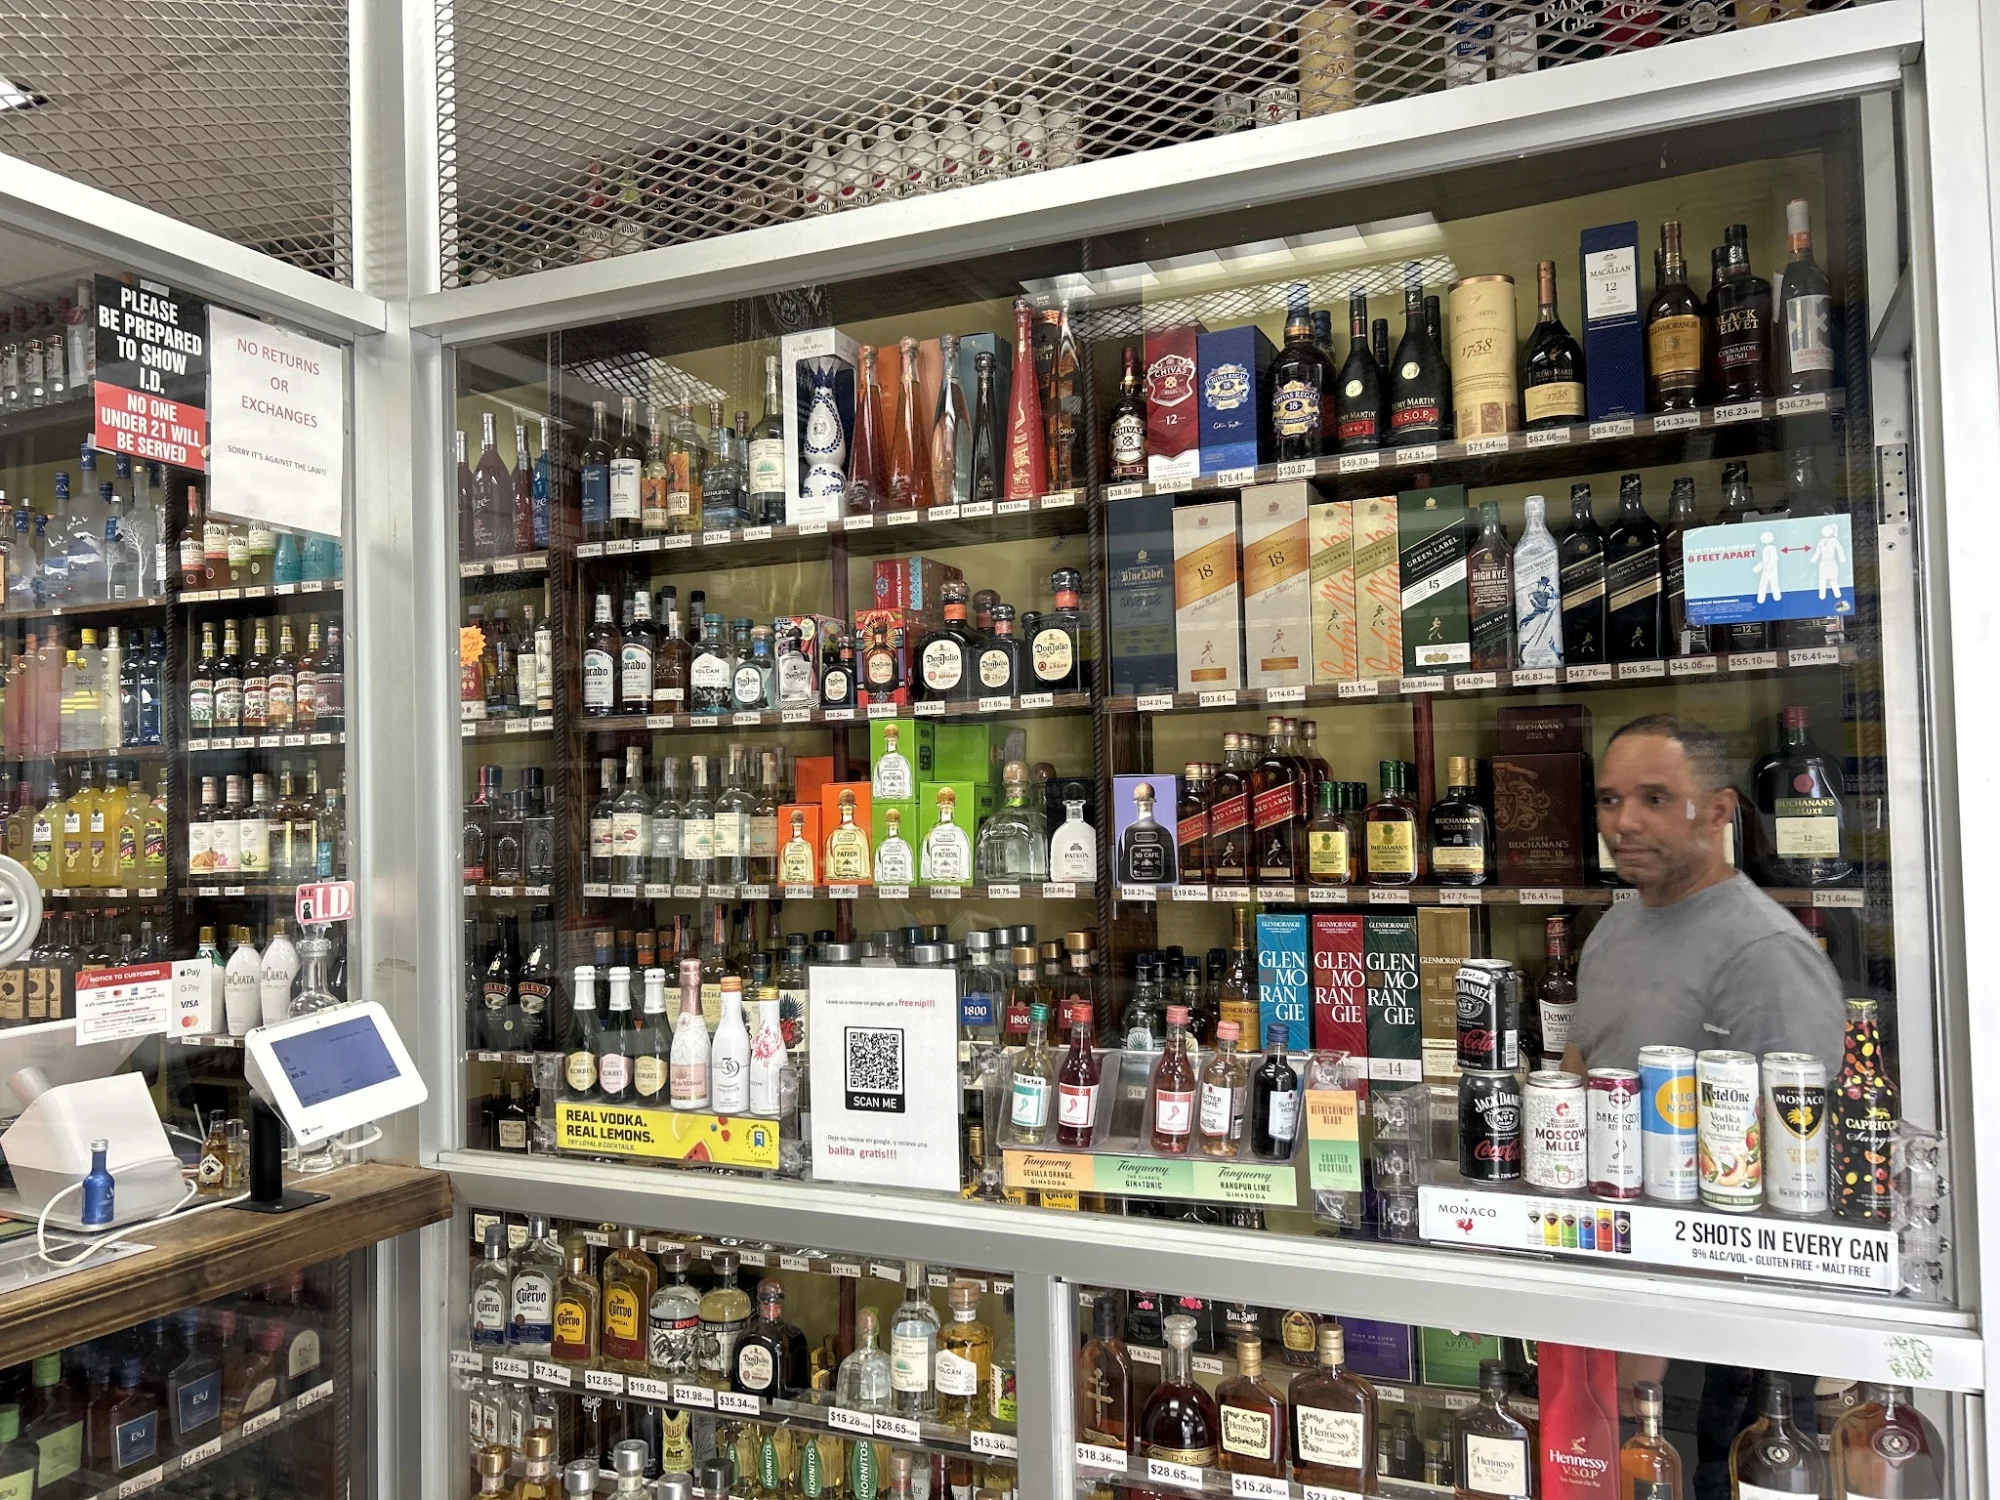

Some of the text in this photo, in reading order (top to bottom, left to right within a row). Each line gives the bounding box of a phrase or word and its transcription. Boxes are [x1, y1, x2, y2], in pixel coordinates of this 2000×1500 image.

[1590, 263, 1632, 277] MACALLAN
[1604, 281, 1617, 292] 12
[120, 287, 178, 325] PLEASE
[99, 305, 202, 356] BE PREPARED
[117, 335, 188, 376] TO SHOW
[1461, 337, 1493, 359] 1738
[1718, 344, 1757, 359] CINNAMON
[237, 338, 321, 376] NO RETURNS
[1726, 352, 1748, 363] RUSH
[1154, 365, 1188, 379] CHIVAS
[140, 367, 166, 394] I.D.
[270, 376, 290, 394] OR
[1273, 389, 1319, 406] CHIVAS REGAL
[1406, 396, 1436, 406] MARTIN
[127, 395, 178, 423] NO ONE
[241, 395, 319, 429] EXCHANGES
[1288, 401, 1299, 411] 18
[1165, 413, 1178, 426] 12
[1349, 410, 1377, 420] MARTIN
[101, 407, 202, 449] UNDER 21 WILL
[1114, 425, 1144, 439] CHIVAS
[116, 431, 187, 463] BE SERVED
[227, 444, 250, 457] SORRY
[264, 454, 294, 469] AGAINST
[294, 462, 308, 472] THE
[1267, 550, 1285, 569] 18
[1688, 549, 1757, 563] 6 FEET APART
[1196, 563, 1214, 581] 18
[1472, 569, 1507, 581] HIGH RYE
[1427, 579, 1440, 590] 15
[1741, 625, 1752, 633] 12
[1254, 794, 1293, 814] RED LABEL
[1775, 797, 1835, 808] BUCHANAN'S
[1434, 816, 1480, 825] BUCHANAN'S
[1442, 823, 1474, 832] MASTER
[1508, 840, 1570, 850] BUCHANAN'S
[1803, 834, 1813, 842] 12
[145, 841, 162, 857] MIX
[300, 884, 352, 919] WE I.D.
[1261, 920, 1301, 929] GLENMORANGIE
[1316, 920, 1359, 930] GLENMORANGIE
[1368, 921, 1411, 930] GLENMORANGIE
[1259, 950, 1306, 969] GLEN
[1313, 951, 1363, 970] GLEN
[1366, 952, 1416, 972] GLEN
[90, 975, 112, 983] NOTICE
[124, 969, 160, 979] CUSTOMERS
[1275, 969, 1309, 987] MO
[1331, 970, 1366, 988] MO
[1383, 971, 1419, 989] MO
[1259, 985, 1298, 1004] RAN
[1315, 986, 1355, 1005] RAN
[1367, 988, 1407, 1007] RAN
[180, 999, 199, 1009] VISA
[898, 998, 914, 1008] free
[963, 1004, 987, 1016] 1800
[1275, 1003, 1306, 1022] GIE
[1331, 1004, 1363, 1023] GIE
[1384, 1006, 1416, 1026] GIE
[1388, 1061, 1403, 1076] 14
[853, 1095, 897, 1109] SCAN ME
[1474, 1092, 1499, 1113] JACK
[1714, 1102, 1750, 1111] BOTANICAL
[1775, 1093, 1825, 1106] MONACO
[566, 1109, 648, 1128] REAL VODKA.
[1709, 1111, 1741, 1123] Vodka
[566, 1125, 655, 1144] REAL LEMONS.
[1535, 1127, 1588, 1140] MOSCOW
[1710, 1121, 1741, 1134] Spritz
[577, 1139, 597, 1147] LOYAL
[828, 1144, 855, 1157] balita
[1545, 1140, 1581, 1152] MULE
[1022, 1154, 1072, 1171] Tanqueray
[1116, 1158, 1170, 1177] Tanqueray
[1317, 1162, 1353, 1174] COCKTAILS
[1022, 1168, 1046, 1180] SEVILLA
[1218, 1164, 1273, 1183] Tanqueray
[1219, 1181, 1271, 1193] RANGPUR LIME
[1437, 1204, 1498, 1219] MONACO
[1675, 1220, 1889, 1263] 2 SHOTS IN EVERY CAN
[1692, 1247, 1871, 1278] 9% ALC/VOL GLUTEN FREE MALT FREE
[525, 1281, 538, 1292] Jose
[516, 1288, 546, 1306] Cuervo
[613, 1294, 625, 1305] Jose
[476, 1300, 500, 1314] Cuervo
[608, 1302, 632, 1319] Cuervo
[556, 1313, 580, 1328] Cuervo
[1443, 1338, 1479, 1350] APPLE
[192, 1389, 208, 1406] E&J
[1229, 1420, 1261, 1437] Hennessy
[1309, 1424, 1351, 1442] Hennessy
[764, 1442, 774, 1487] HORNITOS
[1476, 1455, 1515, 1471] Hennessy
[1548, 1448, 1609, 1473] Hennessy
[807, 1446, 817, 1495] HORNITOS
[859, 1441, 870, 1498] HORNITOS
